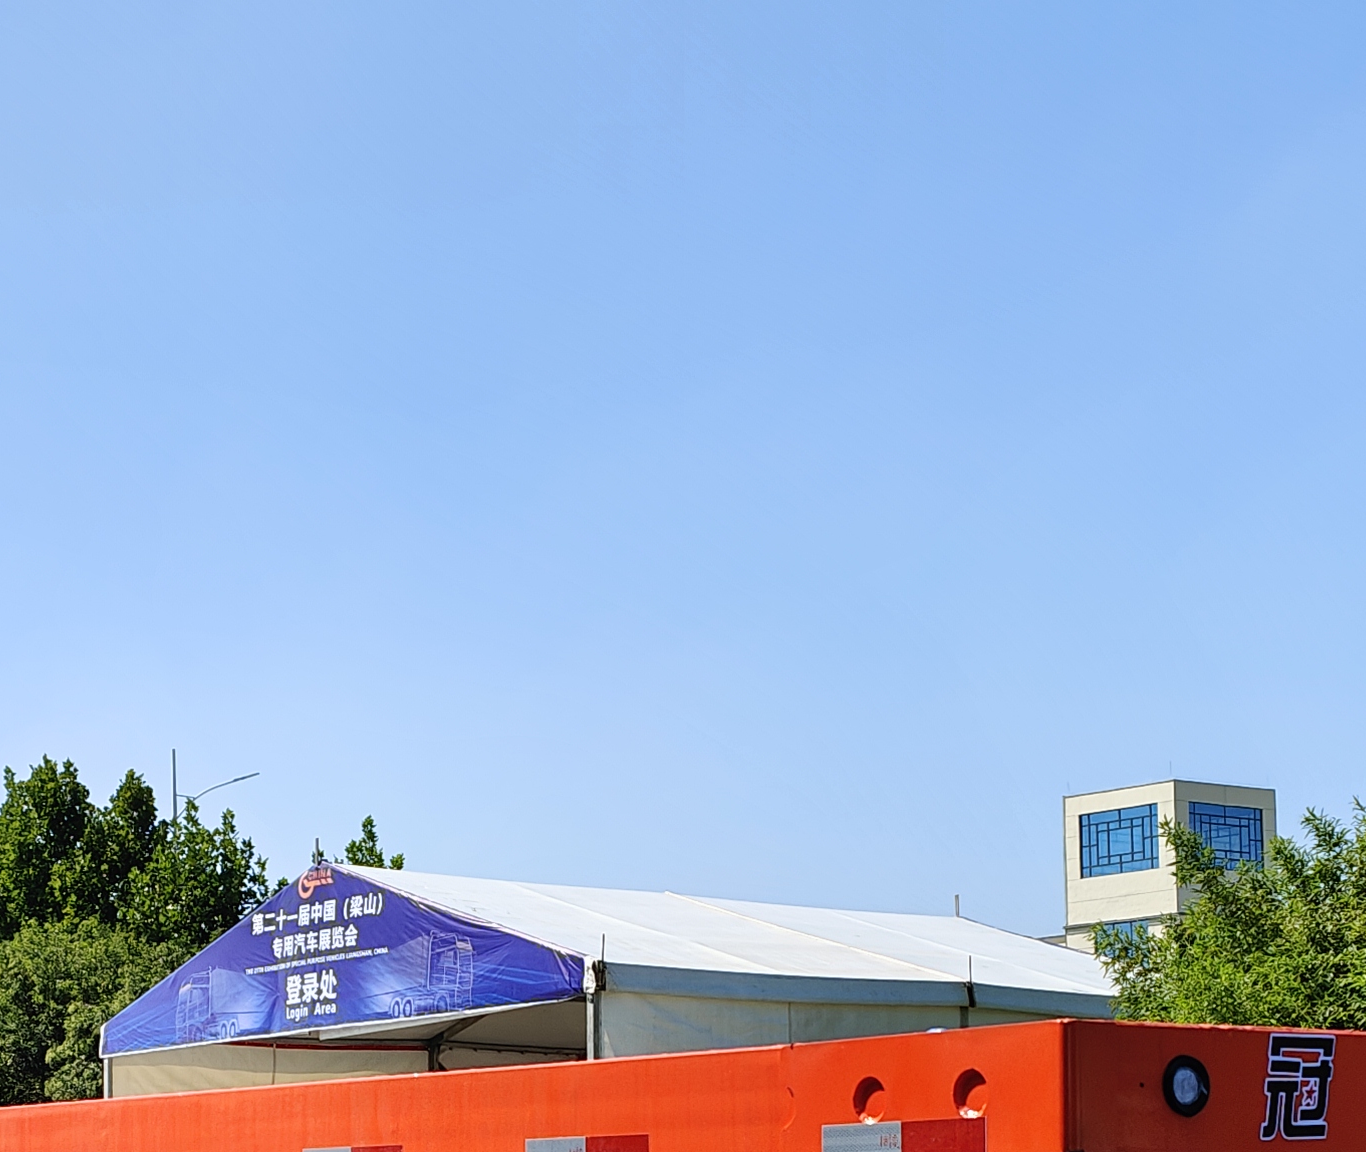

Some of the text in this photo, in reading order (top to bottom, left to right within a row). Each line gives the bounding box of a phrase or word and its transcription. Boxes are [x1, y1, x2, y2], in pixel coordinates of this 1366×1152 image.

[272, 923, 358, 959] 专用汽车展览会
[286, 968, 337, 1005] 登录处
[286, 1002, 336, 1022] Login Area
